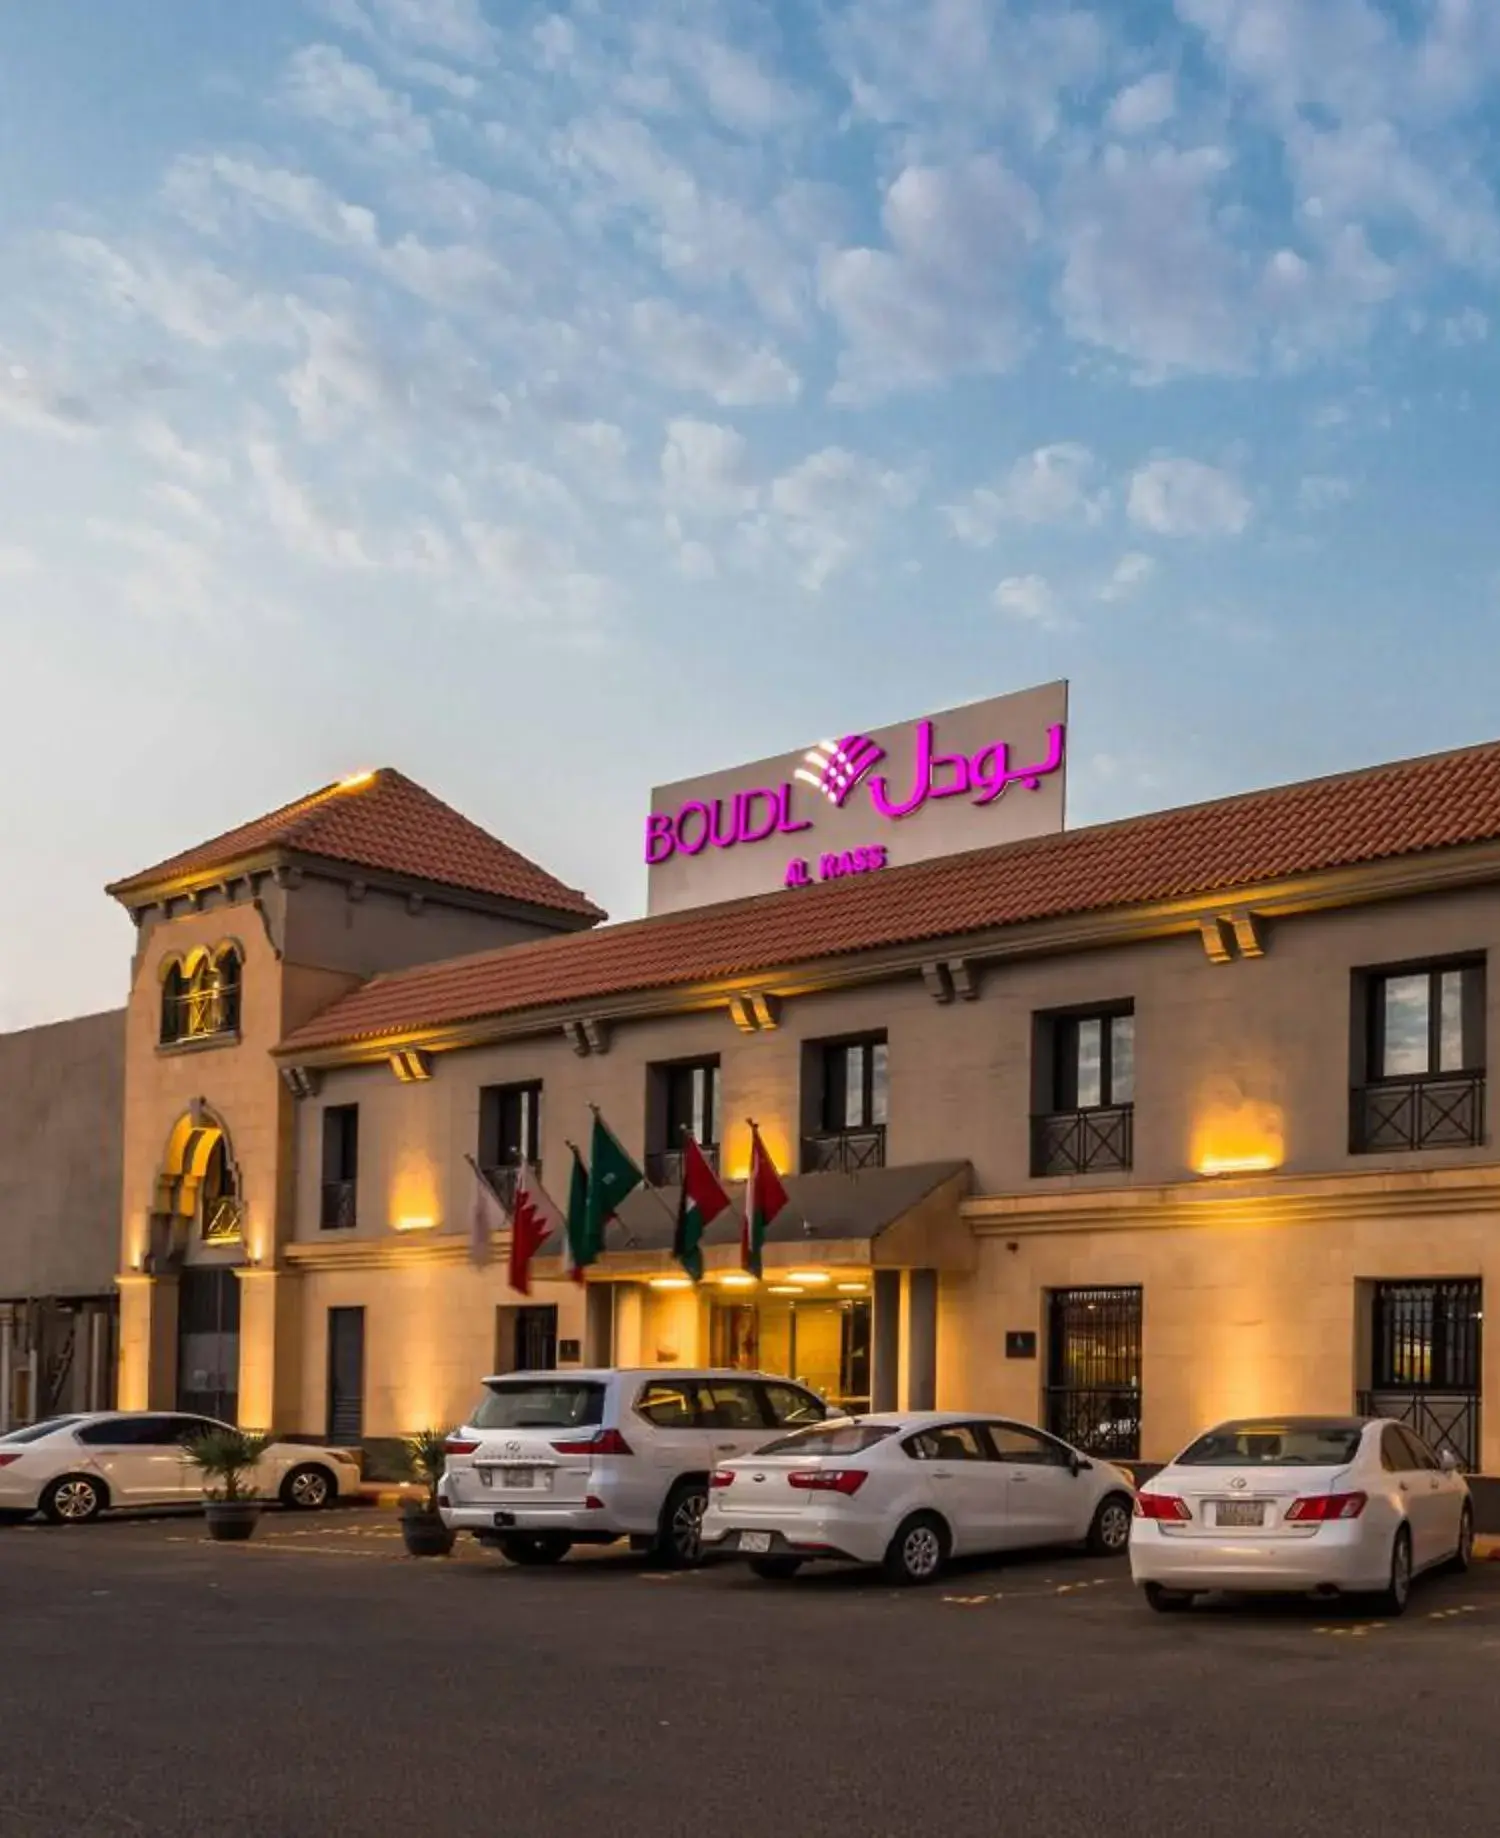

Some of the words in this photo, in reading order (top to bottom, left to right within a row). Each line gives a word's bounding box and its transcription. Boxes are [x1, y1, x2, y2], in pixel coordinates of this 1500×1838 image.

[868, 718, 1064, 818] بودل
[645, 784, 812, 864] BOUDL
[784, 858, 813, 887] AL
[818, 845, 887, 880] RASS
